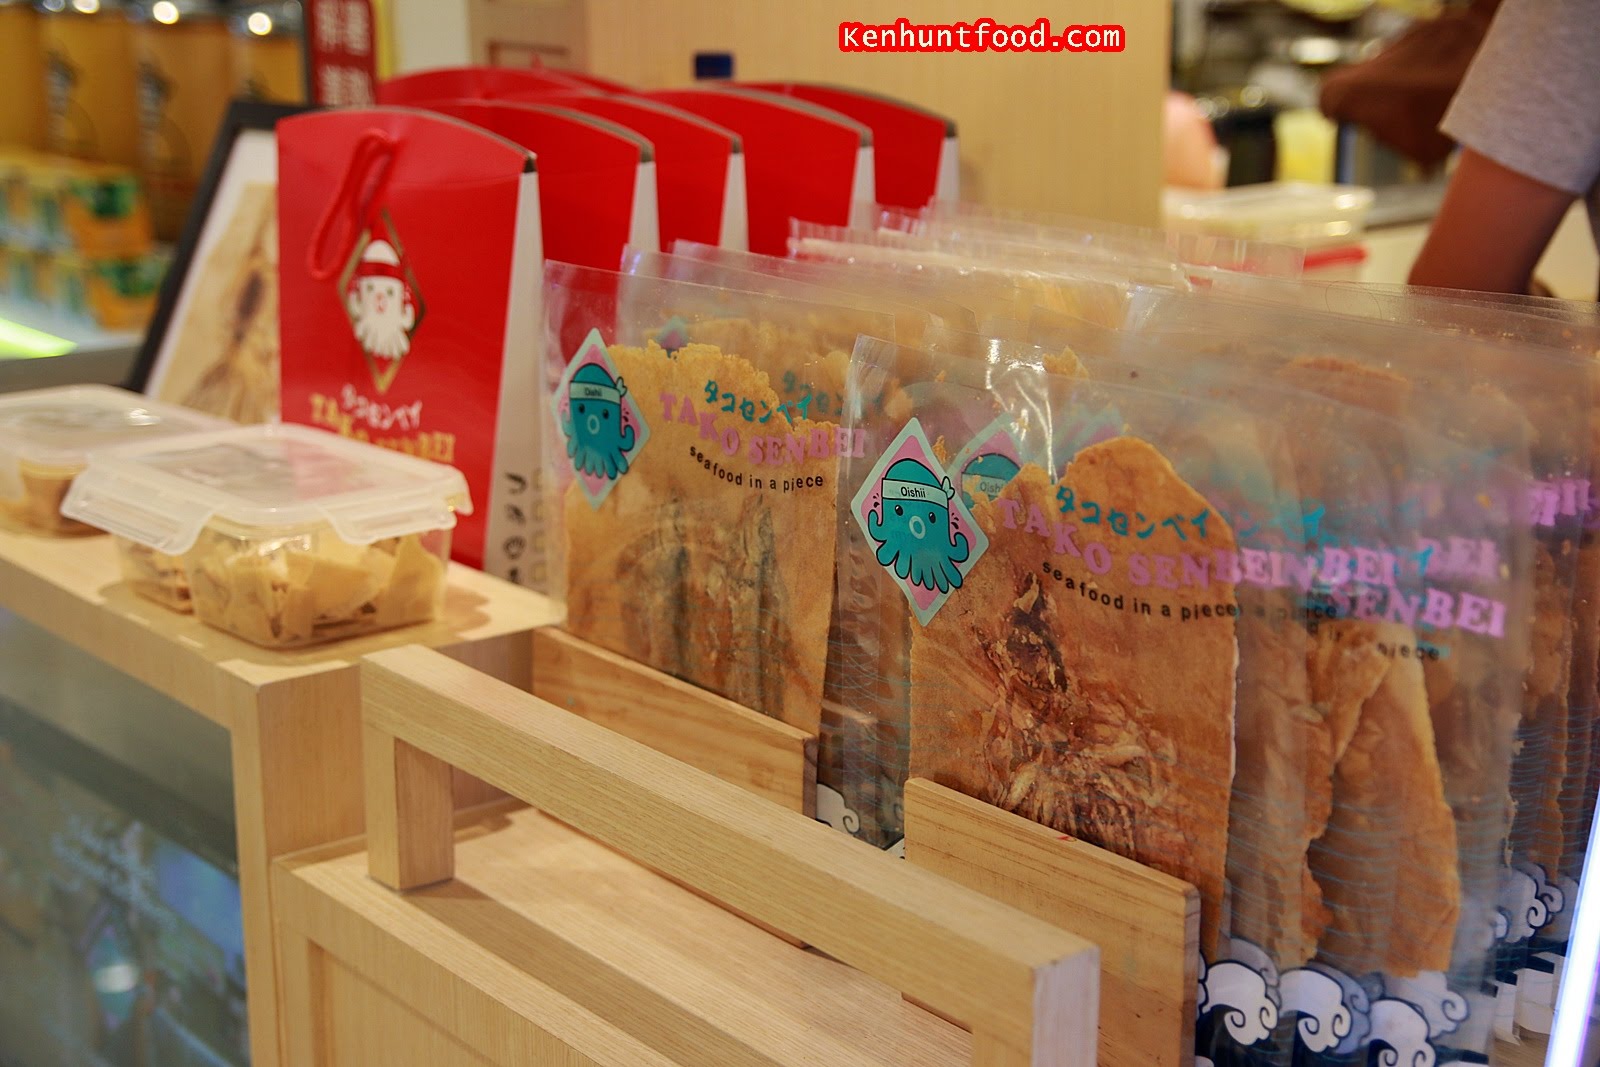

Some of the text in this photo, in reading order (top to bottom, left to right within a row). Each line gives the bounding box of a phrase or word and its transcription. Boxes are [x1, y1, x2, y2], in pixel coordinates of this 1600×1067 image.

[659, 393, 866, 466] TAKO SENBEI
[689, 444, 824, 493] seafood in a piece
[900, 486, 926, 498] Oishii
[1000, 499, 1112, 575] TAKO
[1042, 560, 1237, 620] seafood in a piece
